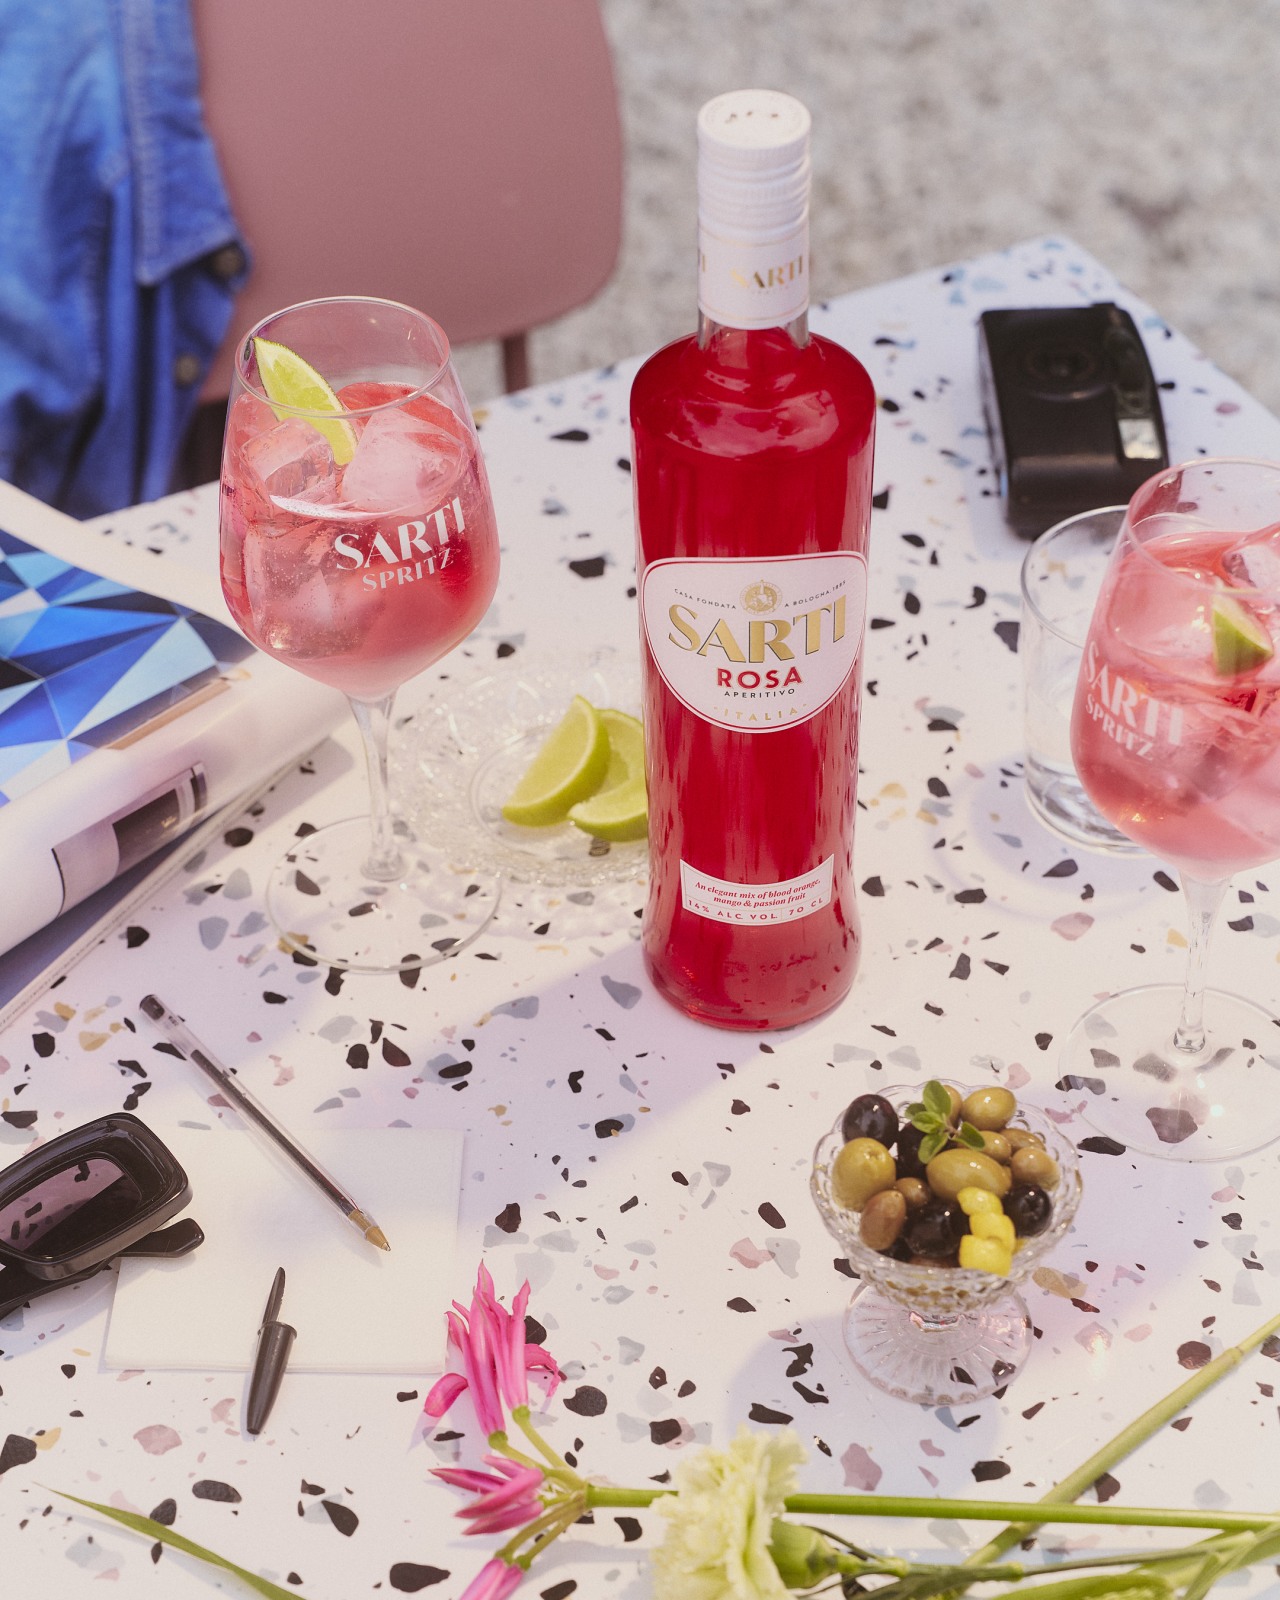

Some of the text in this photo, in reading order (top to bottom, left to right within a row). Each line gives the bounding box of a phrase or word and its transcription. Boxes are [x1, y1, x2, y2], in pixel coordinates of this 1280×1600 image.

[334, 496, 466, 570] SARTI
[362, 547, 454, 592] SPRITZ
[674, 588, 693, 600] CASA
[696, 597, 736, 609] FONDATA
[668, 594, 847, 664] SARTI
[716, 666, 803, 689] ROSA
[724, 688, 795, 699] APERITIVO
[1084, 640, 1184, 747] SARTI
[724, 707, 798, 721] ITALIA
[1085, 693, 1154, 761] SPRITZ
[695, 881, 706, 891] An
[707, 886, 737, 898] elegant
[757, 891, 768, 900] of
[768, 887, 792, 899] blood
[713, 892, 806, 909] mango & passion fruit
[688, 899, 710, 913] 14%
[789, 906, 804, 916] 70
[810, 897, 824, 907] CL
